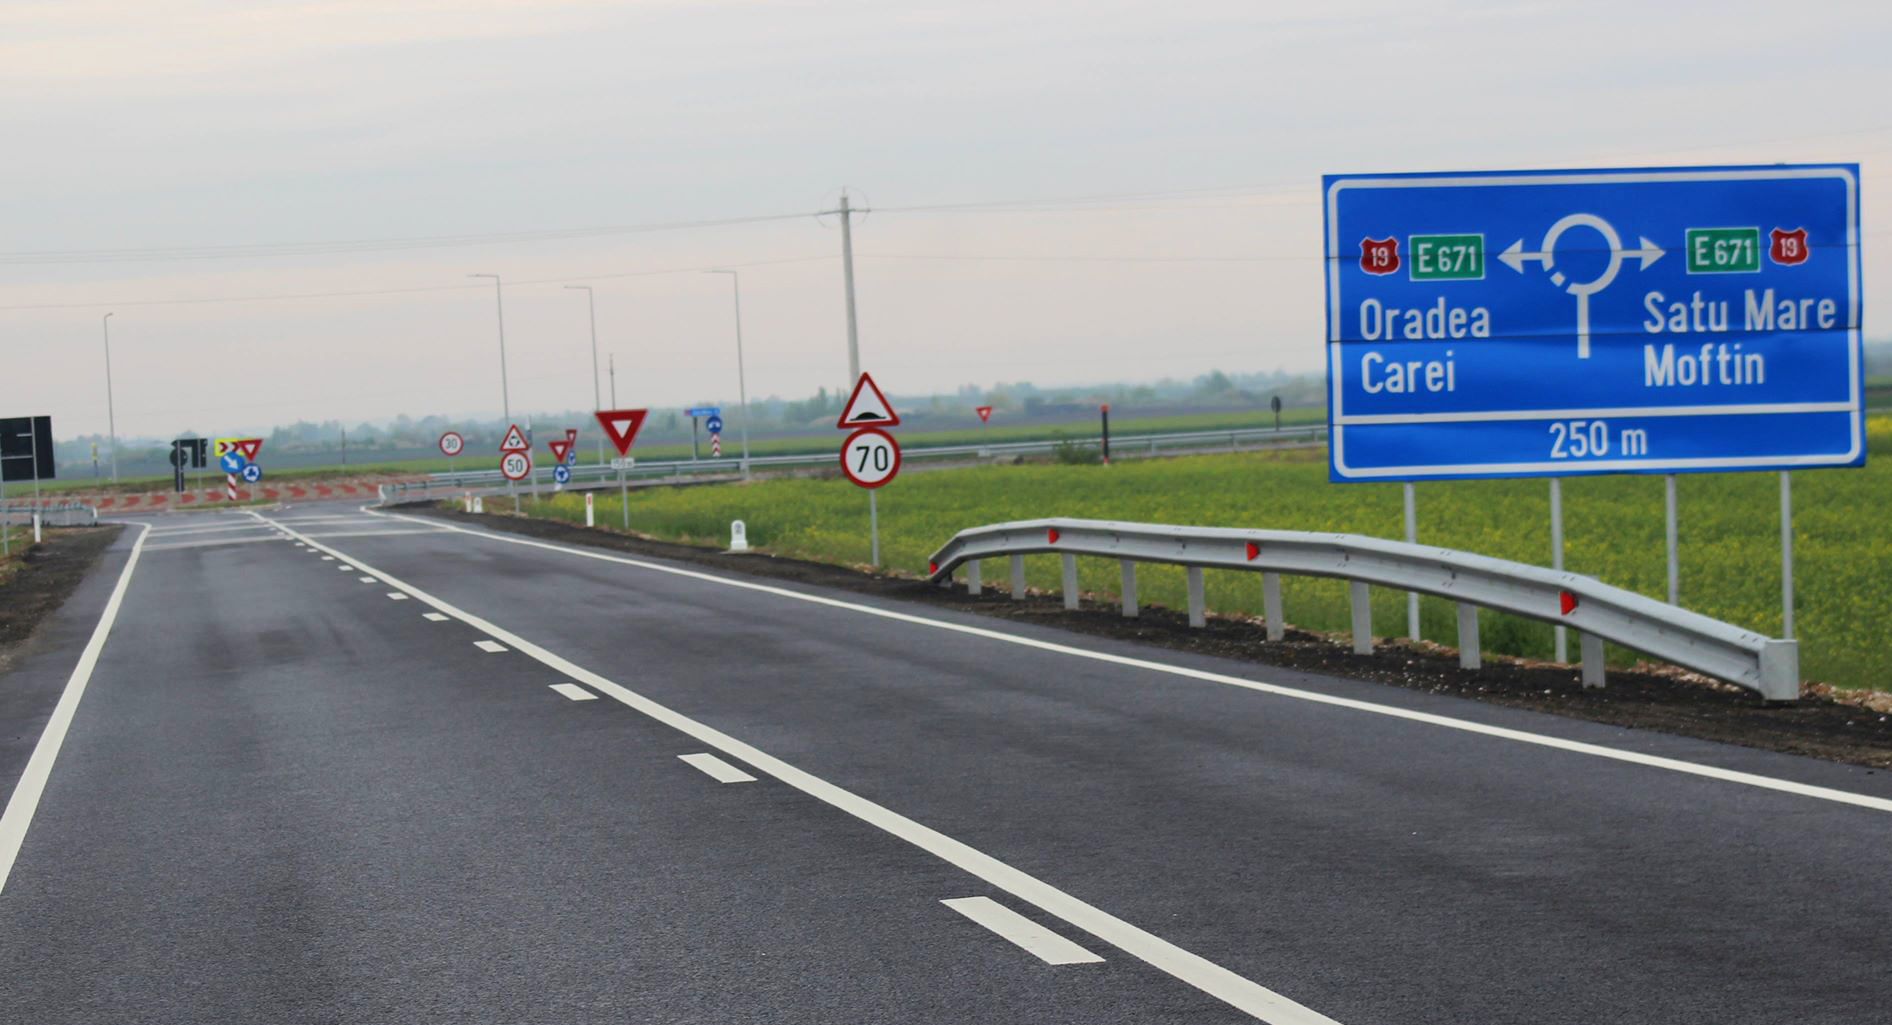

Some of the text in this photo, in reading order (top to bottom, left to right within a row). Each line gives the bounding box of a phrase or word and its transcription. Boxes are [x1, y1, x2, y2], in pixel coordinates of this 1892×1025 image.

[1371, 246, 1389, 267] 19
[1780, 237, 1798, 257] 19
[1360, 297, 1490, 341] Oradea
[1644, 288, 1836, 333] Satu Mare
[1361, 350, 1454, 394] Carei
[1644, 343, 1765, 386] Moftin
[1549, 420, 1647, 458] 250 m
[507, 459, 523, 473] 50
[856, 445, 888, 472] 70
